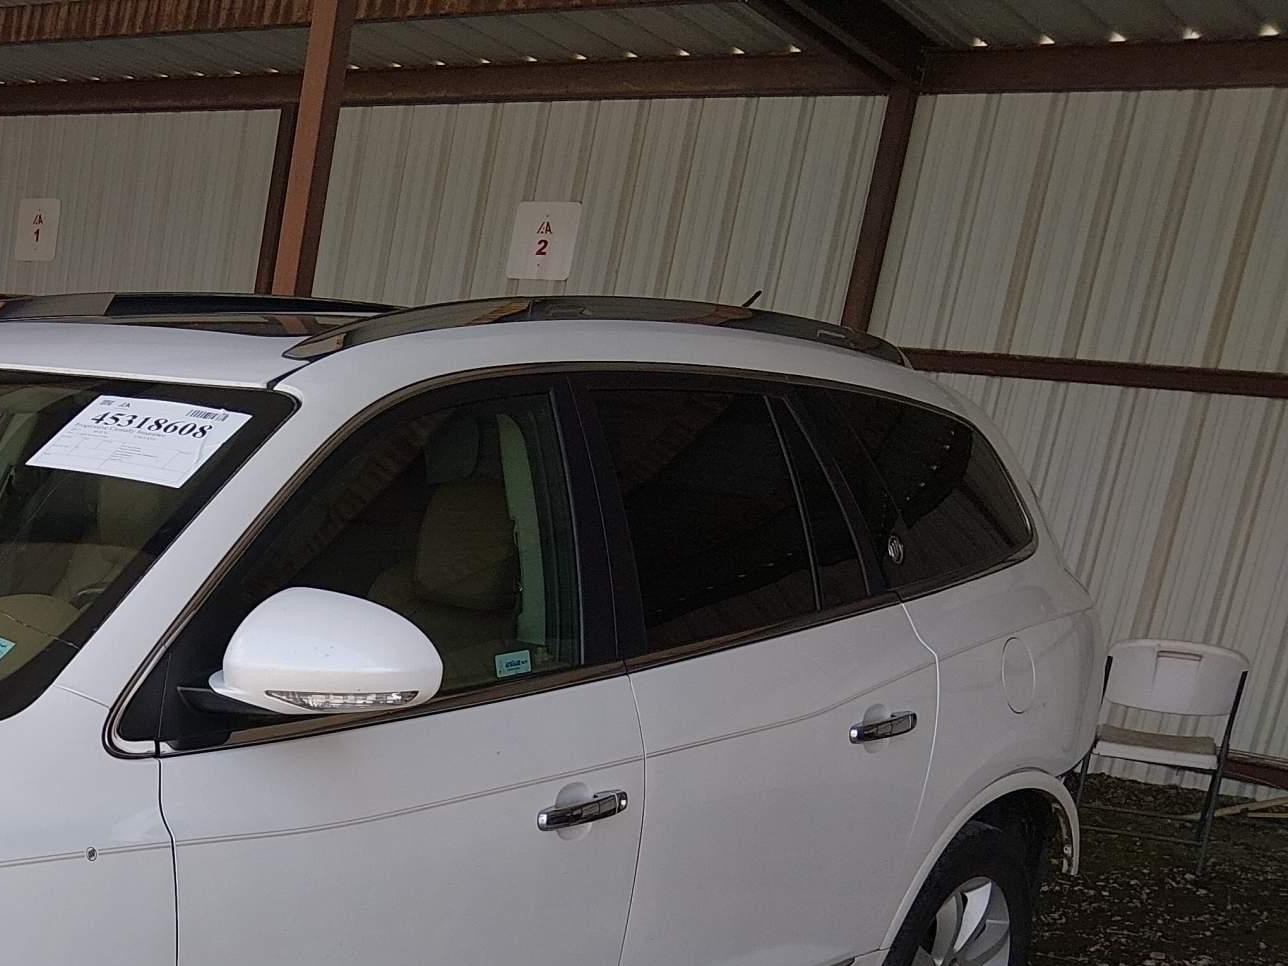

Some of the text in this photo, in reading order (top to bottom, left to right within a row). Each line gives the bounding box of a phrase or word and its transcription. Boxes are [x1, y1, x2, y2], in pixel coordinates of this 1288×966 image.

[33, 228, 40, 242] 1
[535, 239, 549, 256] 2
[90, 410, 213, 439] 45318608
